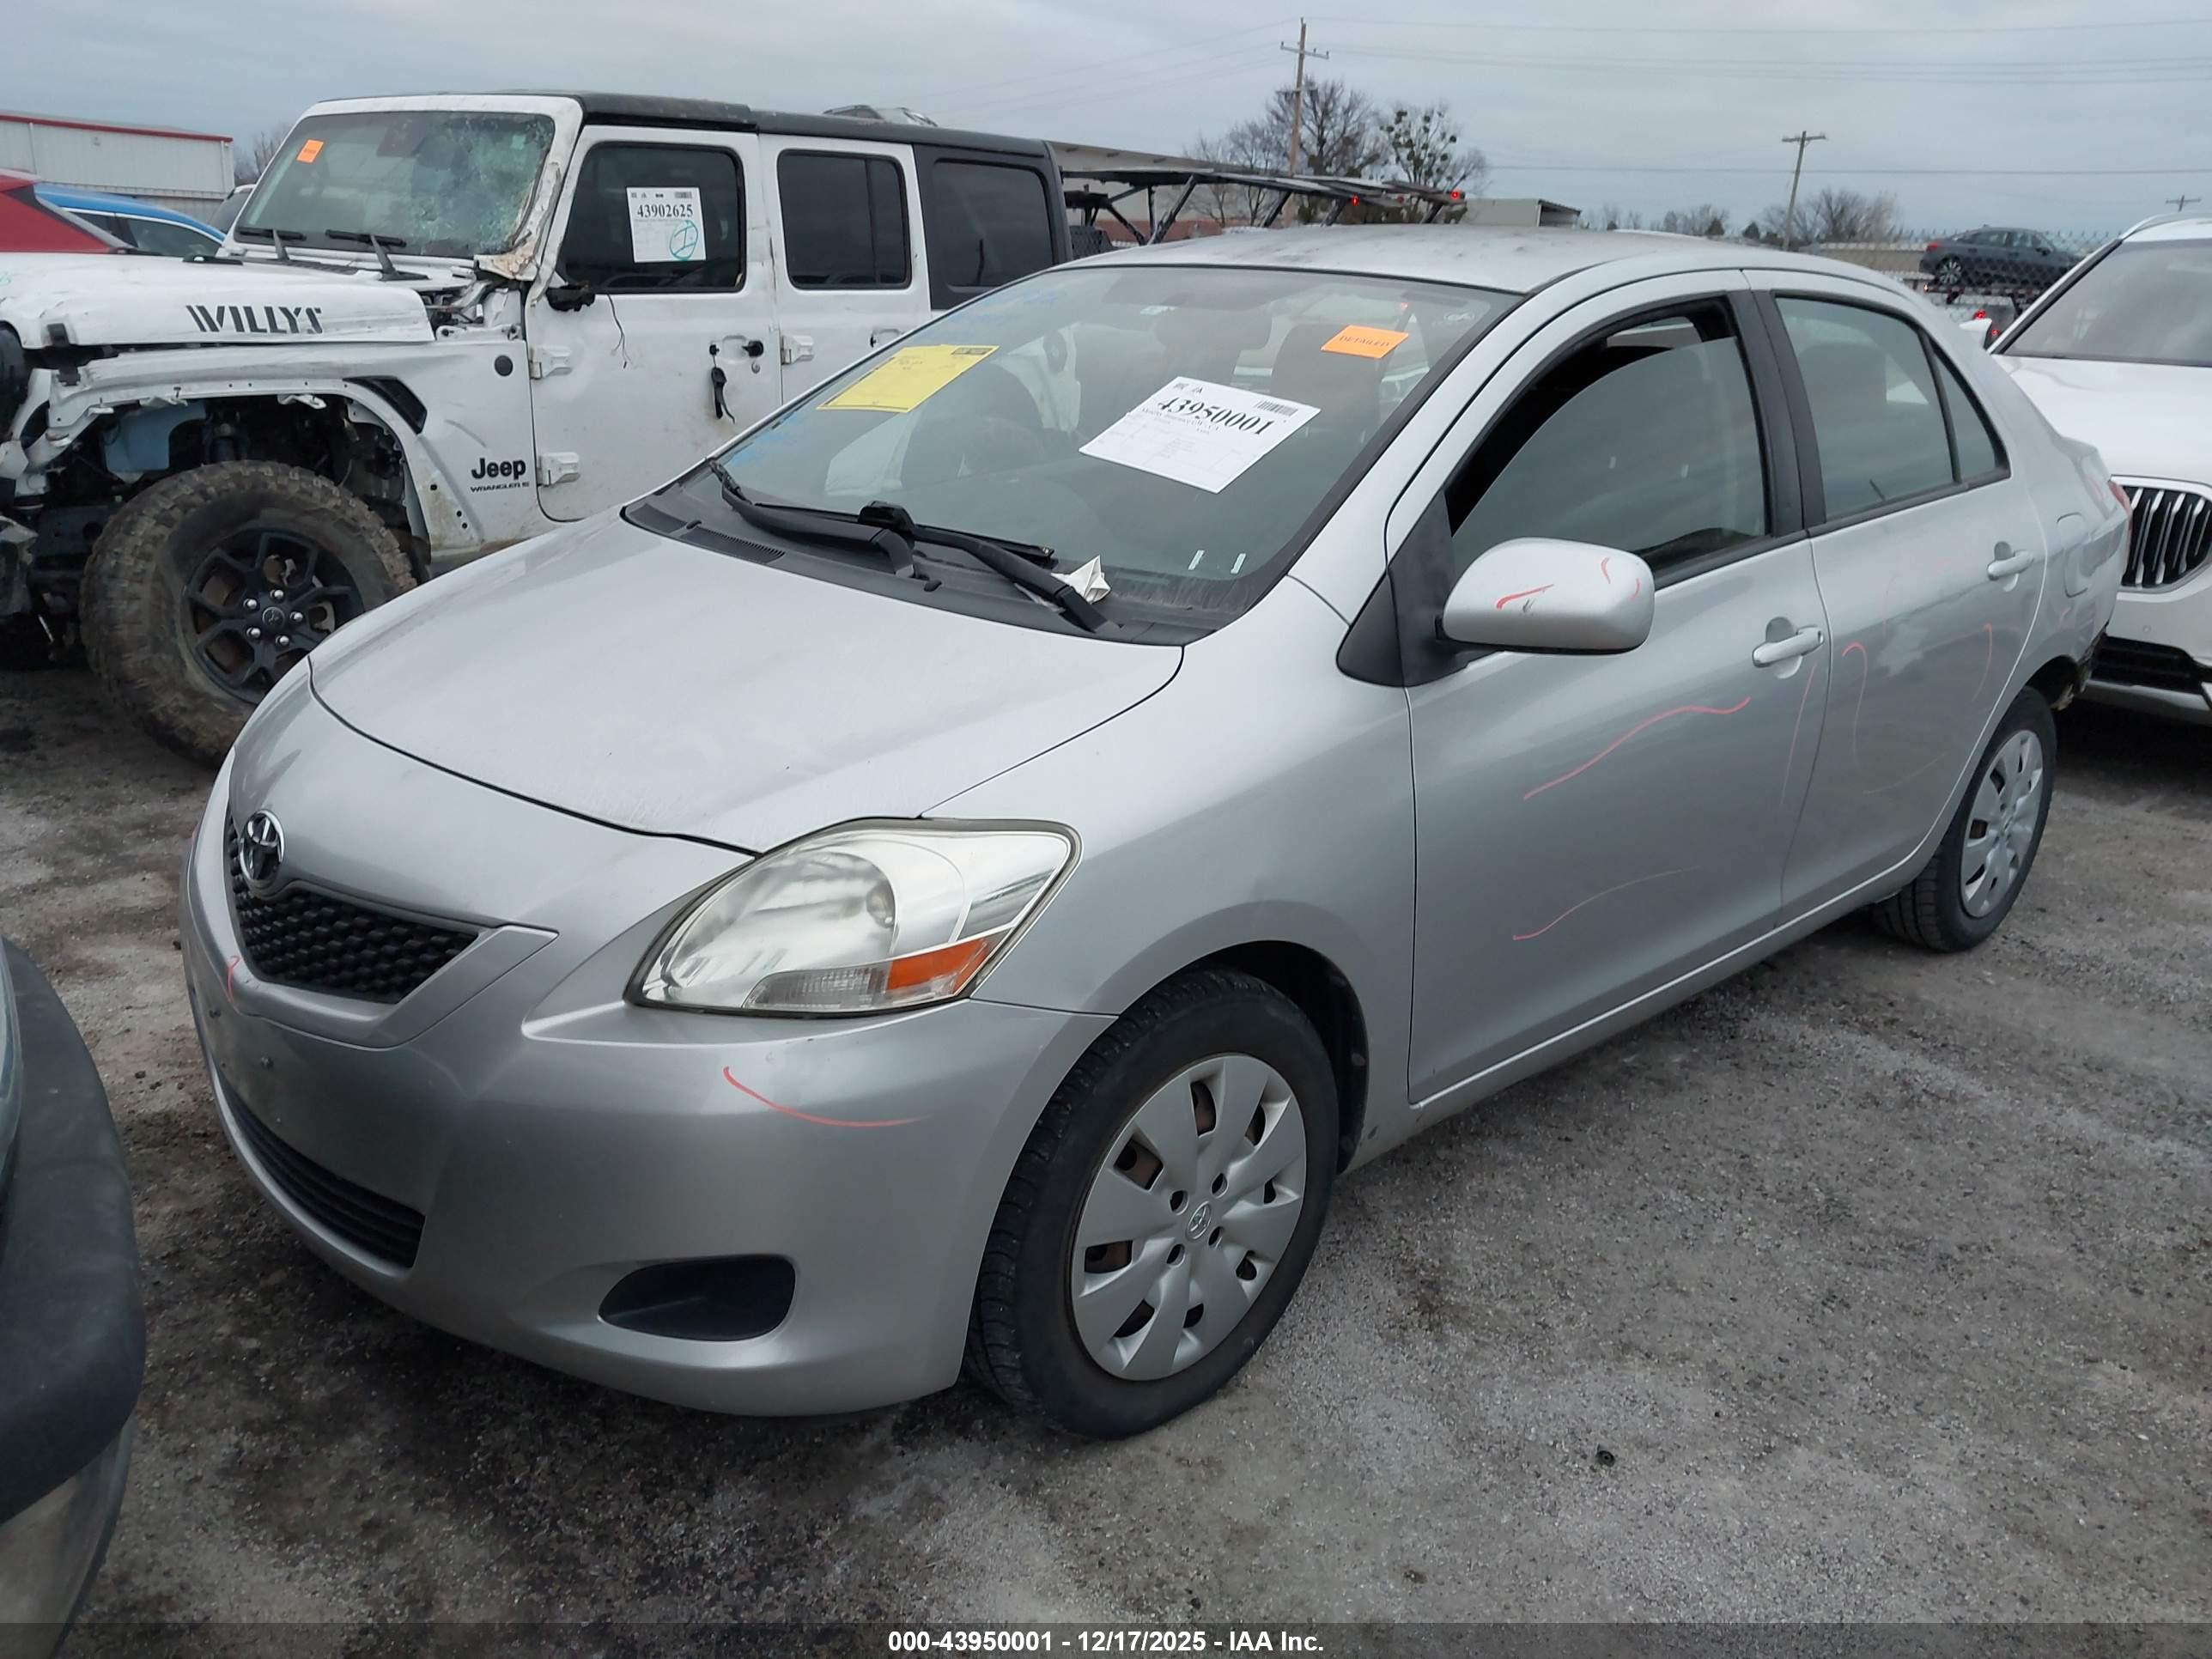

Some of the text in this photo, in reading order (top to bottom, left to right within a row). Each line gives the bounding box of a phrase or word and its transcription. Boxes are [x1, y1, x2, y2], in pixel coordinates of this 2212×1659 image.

[637, 204, 694, 218] 43902625
[185, 305, 324, 334] WILLYS
[1158, 397, 1274, 435] 43950001
[471, 457, 526, 480] Jeep
